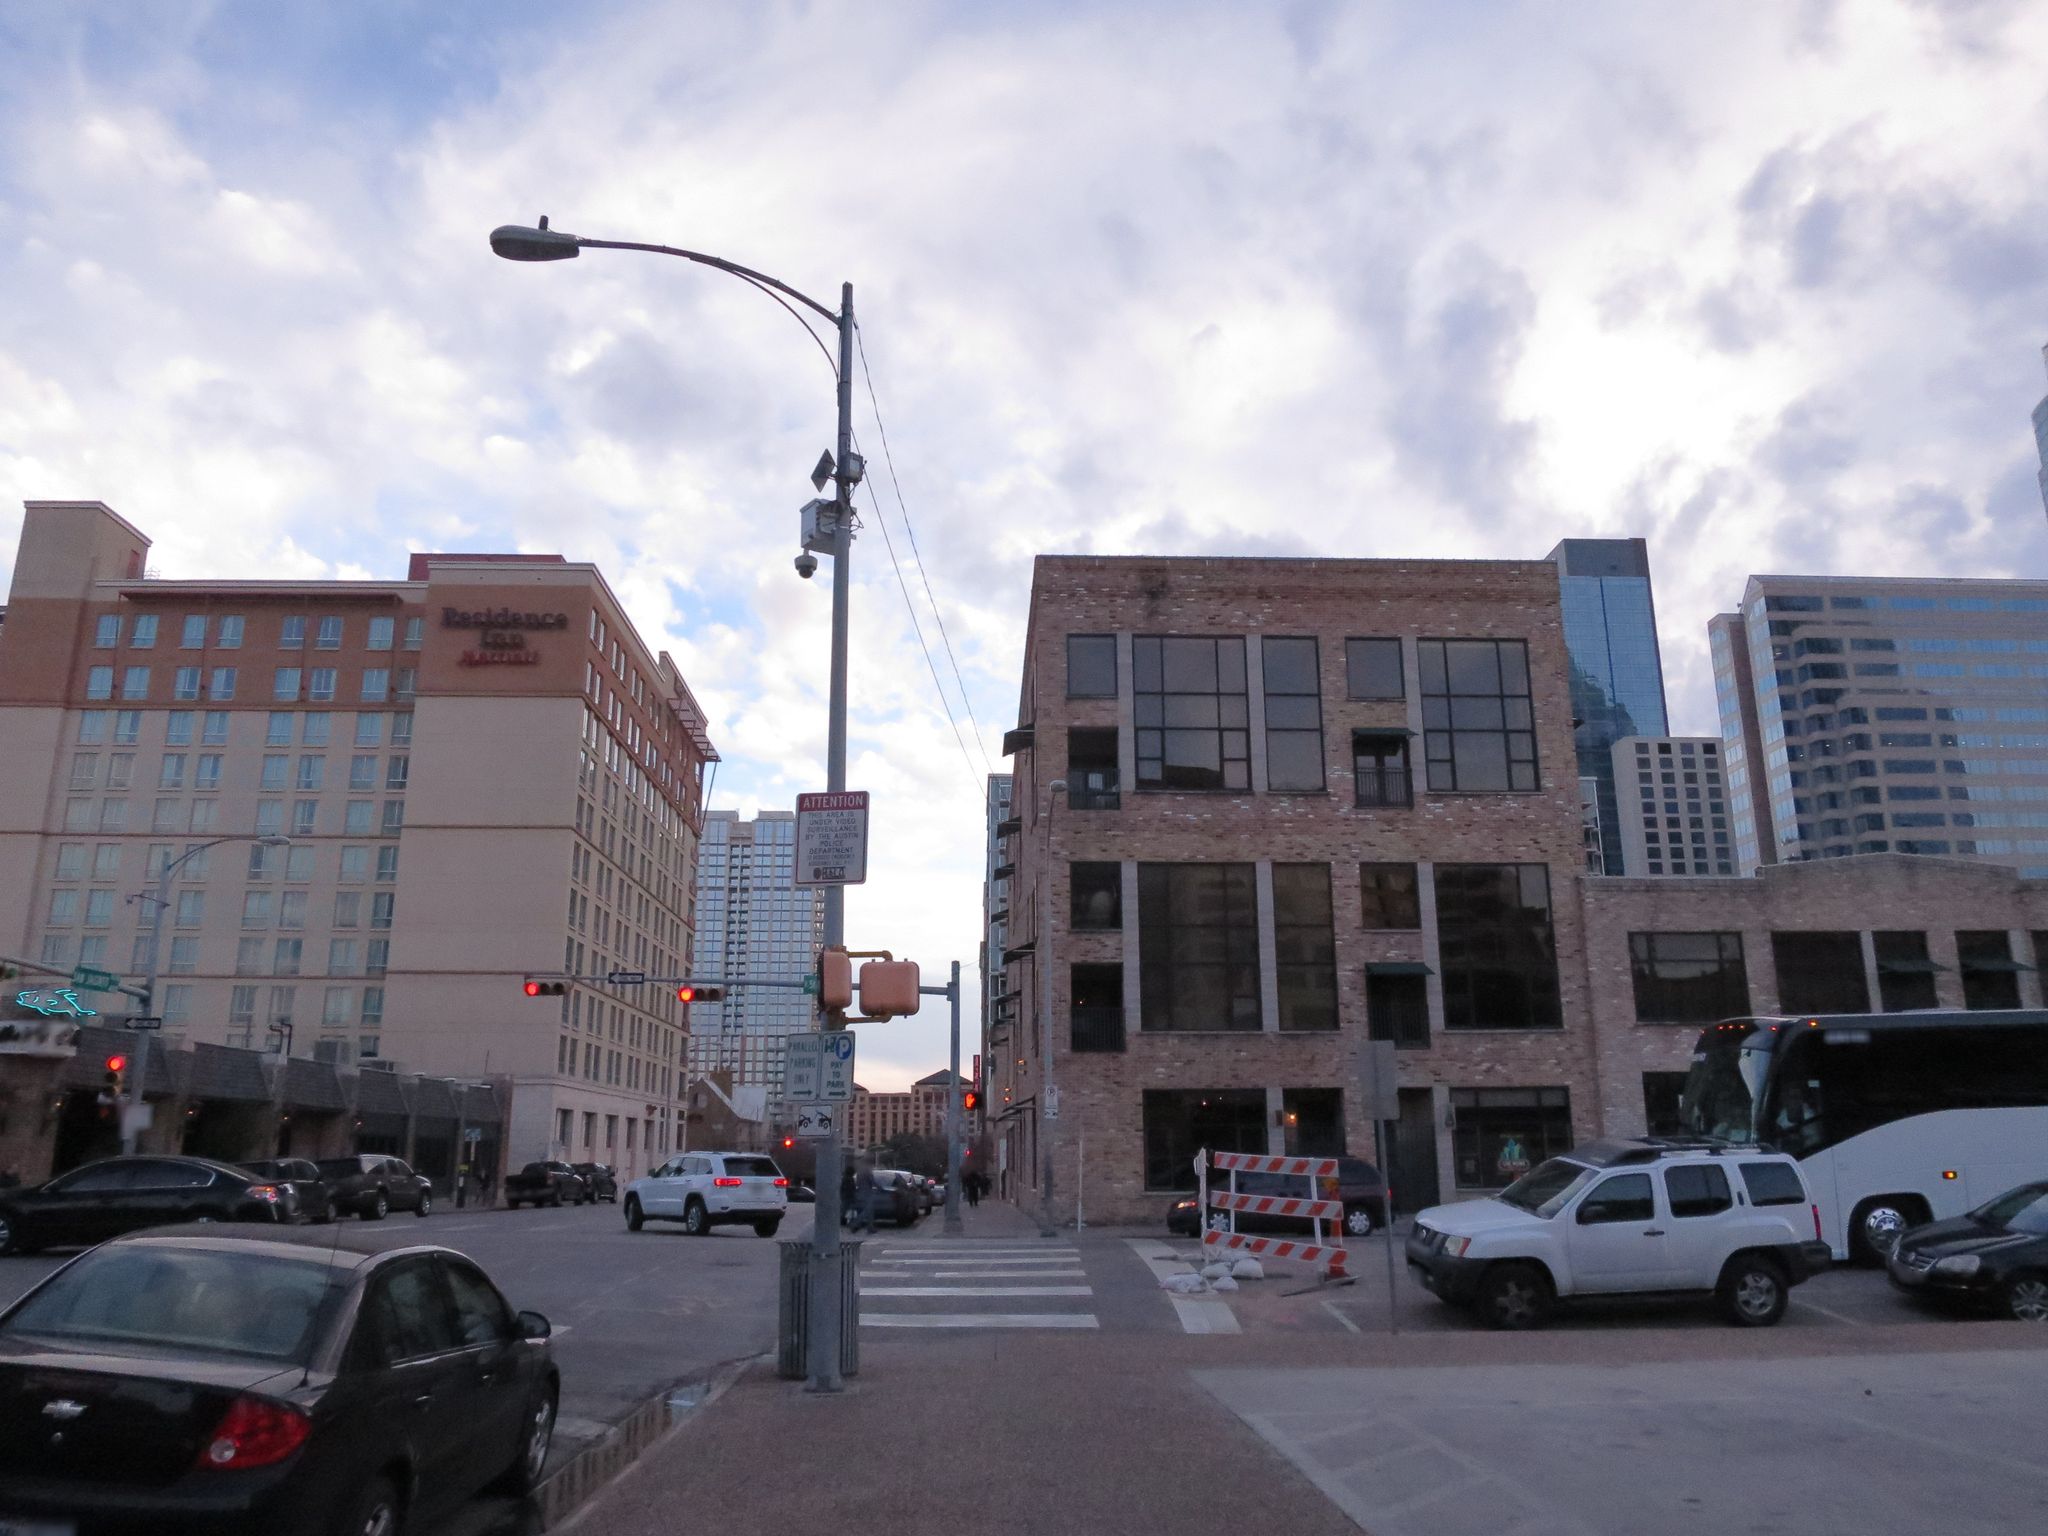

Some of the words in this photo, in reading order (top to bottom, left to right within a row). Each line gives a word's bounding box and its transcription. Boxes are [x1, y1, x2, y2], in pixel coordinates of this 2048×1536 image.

[441, 607, 568, 630] Residence
[803, 795, 863, 808] ATTENTION
[809, 847, 854, 855] DEPARTMENT
[830, 1061, 843, 1069] PAY
[832, 1071, 841, 1079] TO
[826, 1080, 845, 1088] PARK
